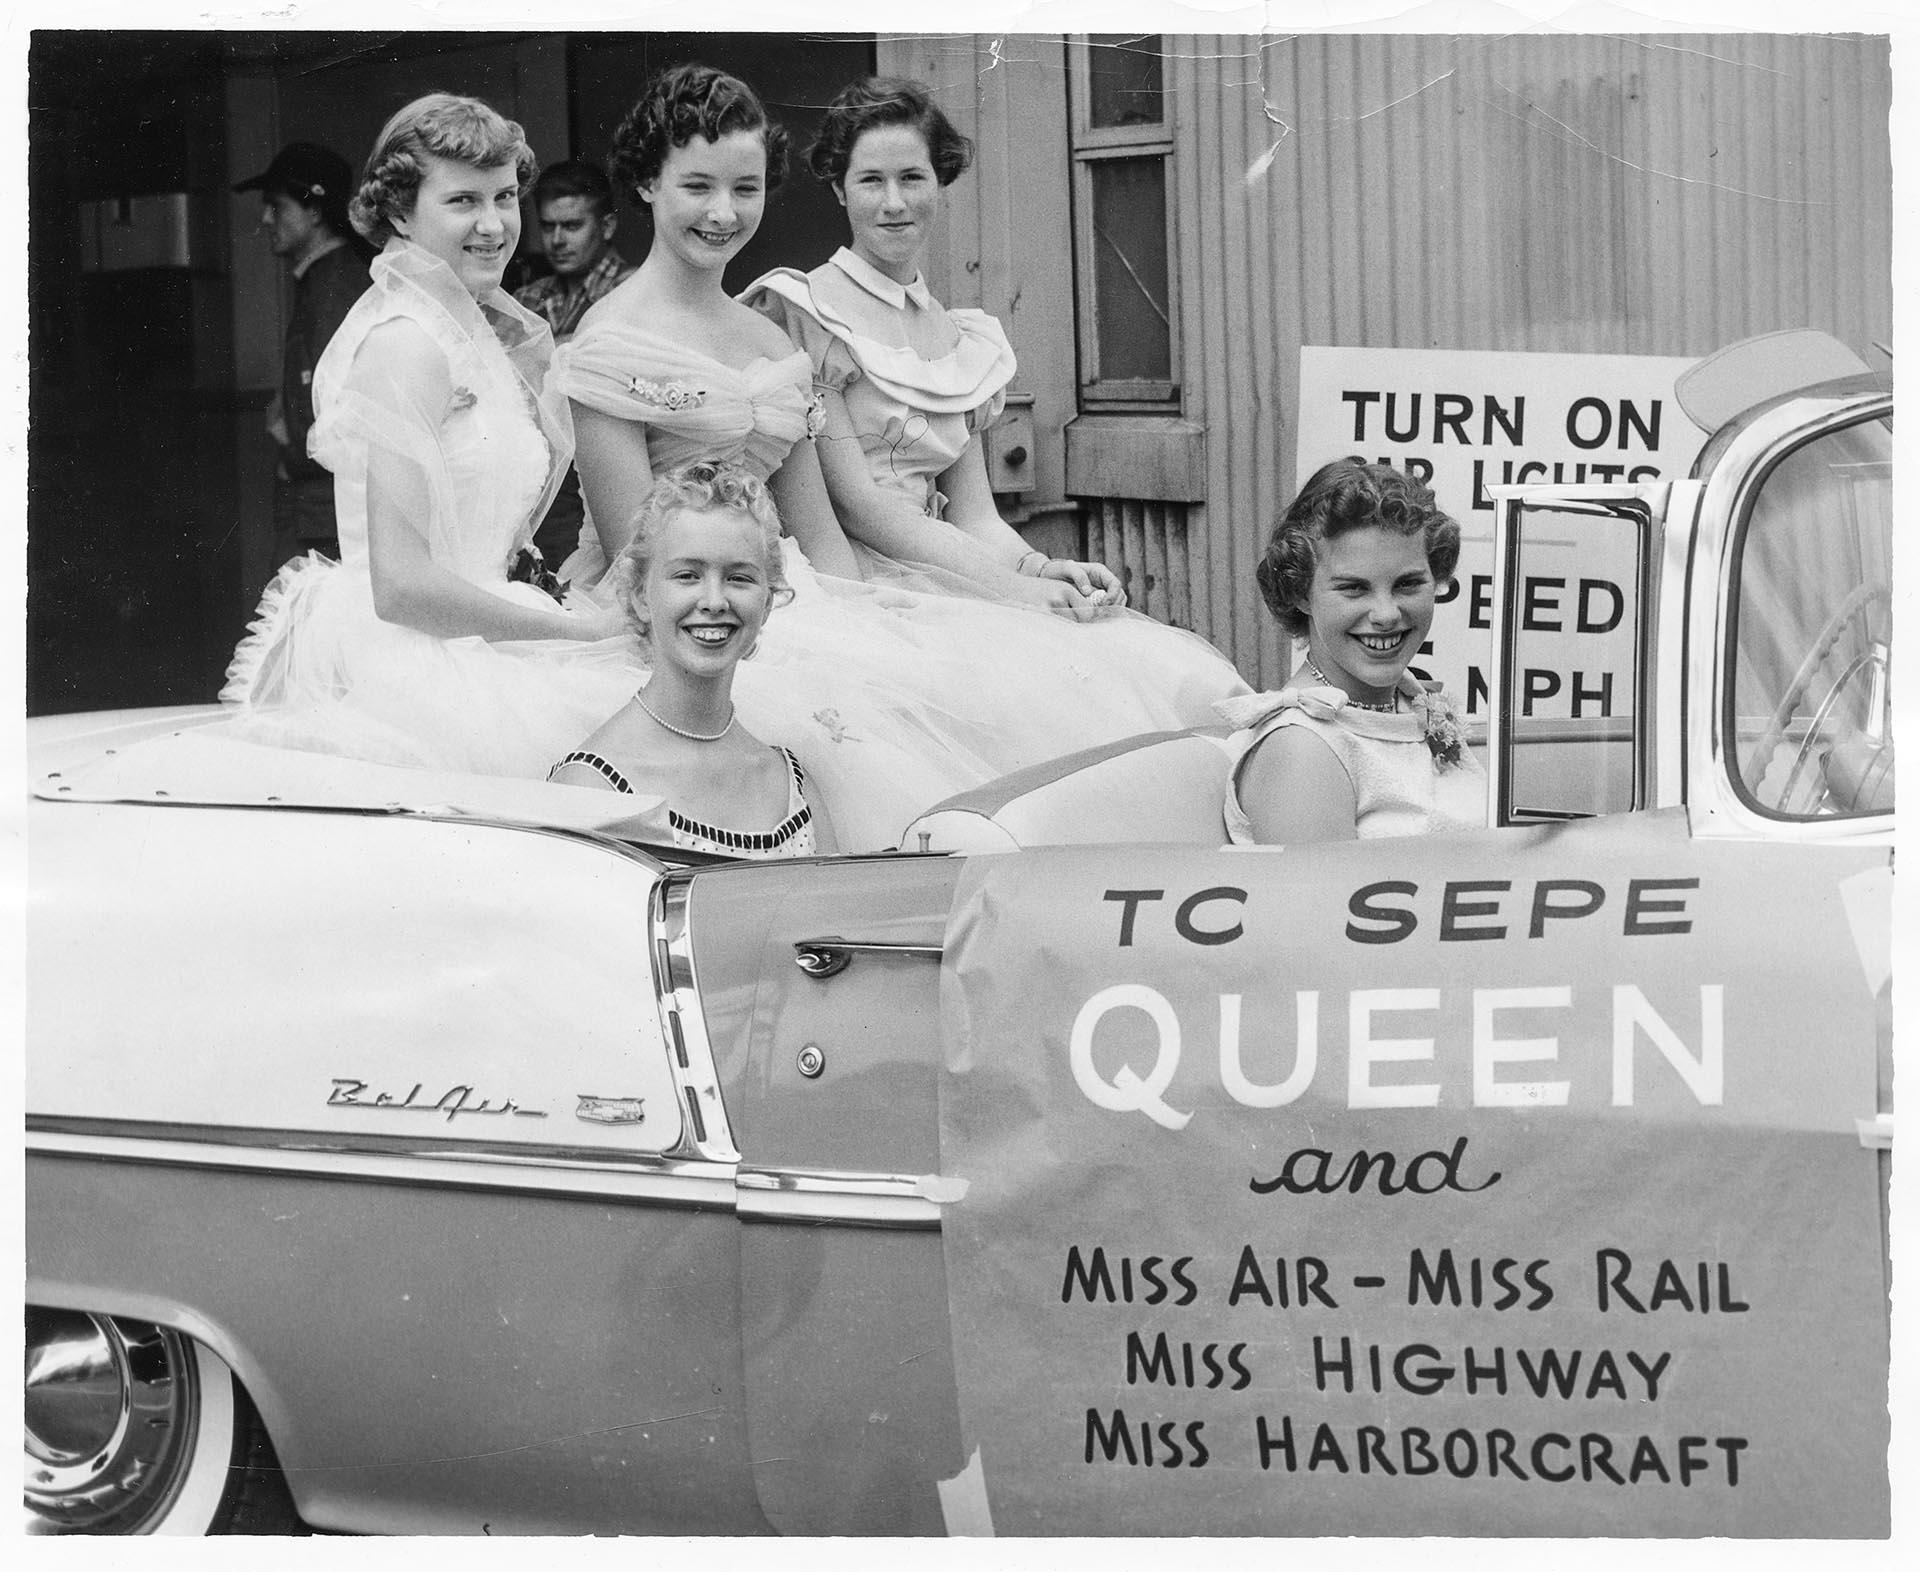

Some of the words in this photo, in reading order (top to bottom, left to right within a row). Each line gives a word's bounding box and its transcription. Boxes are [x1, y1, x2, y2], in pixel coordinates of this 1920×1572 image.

[1342, 391, 1526, 446] TURN
[1565, 397, 1663, 451] ON
[1434, 575, 1624, 633] EED
[1103, 886, 1249, 946] TC
[1345, 878, 1701, 944] SEPE
[1069, 983, 1725, 1130] QUEEN
[326, 1079, 422, 1108] Bel
[434, 1085, 549, 1122] Air
[1250, 1136, 1502, 1195] and
[1229, 1244, 1339, 1309] AIR
[1597, 1248, 1750, 1314] RAIL
[1313, 1335, 1671, 1401] HIGHWAY
[1256, 1415, 1748, 1487] HARBORCRAFT
